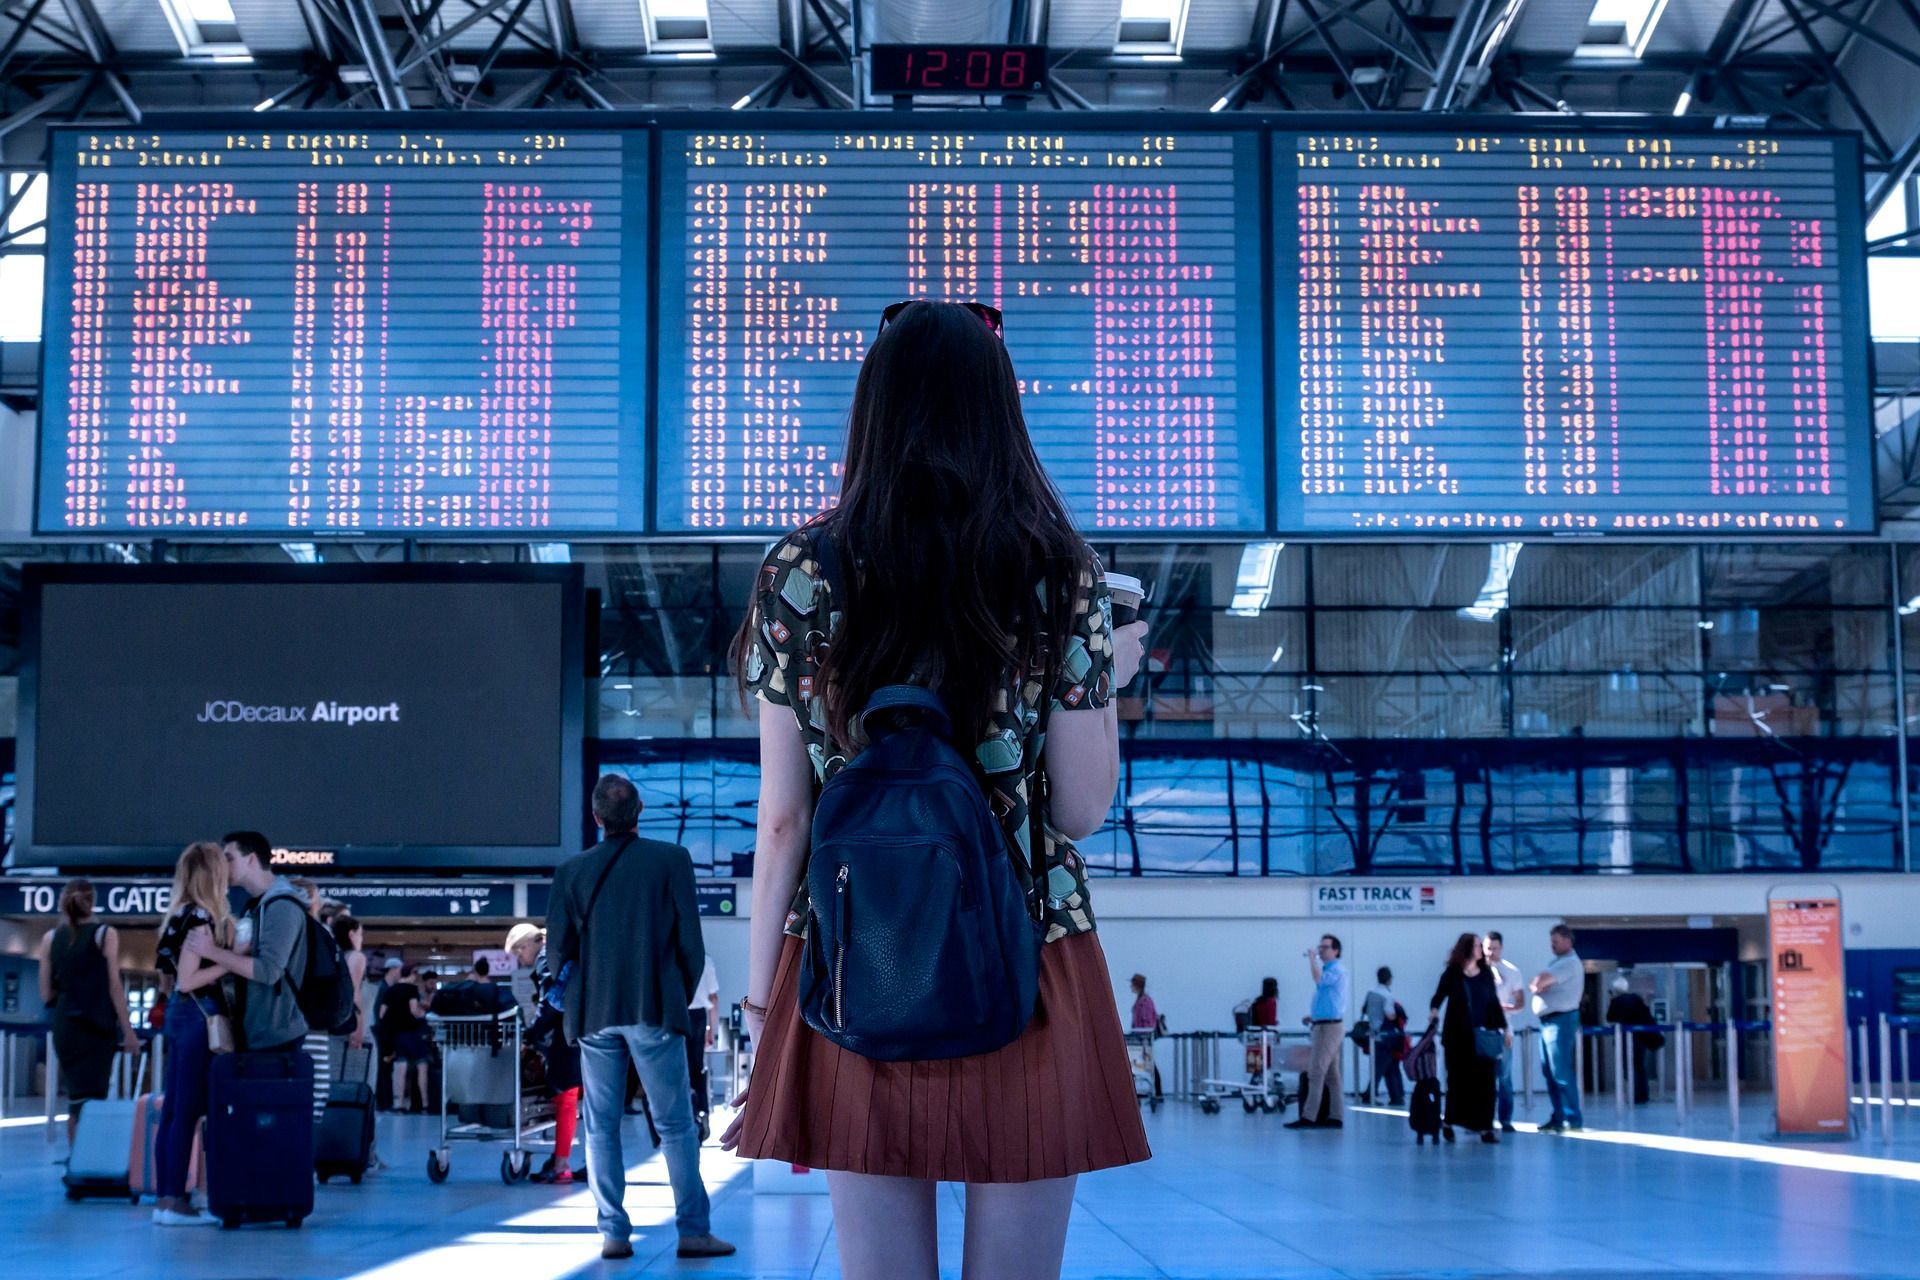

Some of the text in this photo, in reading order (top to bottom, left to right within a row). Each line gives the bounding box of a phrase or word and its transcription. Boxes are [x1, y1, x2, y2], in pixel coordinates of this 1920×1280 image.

[904, 50, 1026, 88] 12:08
[197, 700, 400, 726] JCDecaux Airport
[19, 886, 55, 912] TO
[327, 888, 348, 897] YOUR
[349, 888, 387, 897] PASSPORT
[388, 888, 404, 897] AND
[405, 888, 443, 897] BOARDING
[445, 888, 463, 897] PASS
[464, 888, 490, 897] READY
[1319, 887, 1412, 900] FAST TRACK
